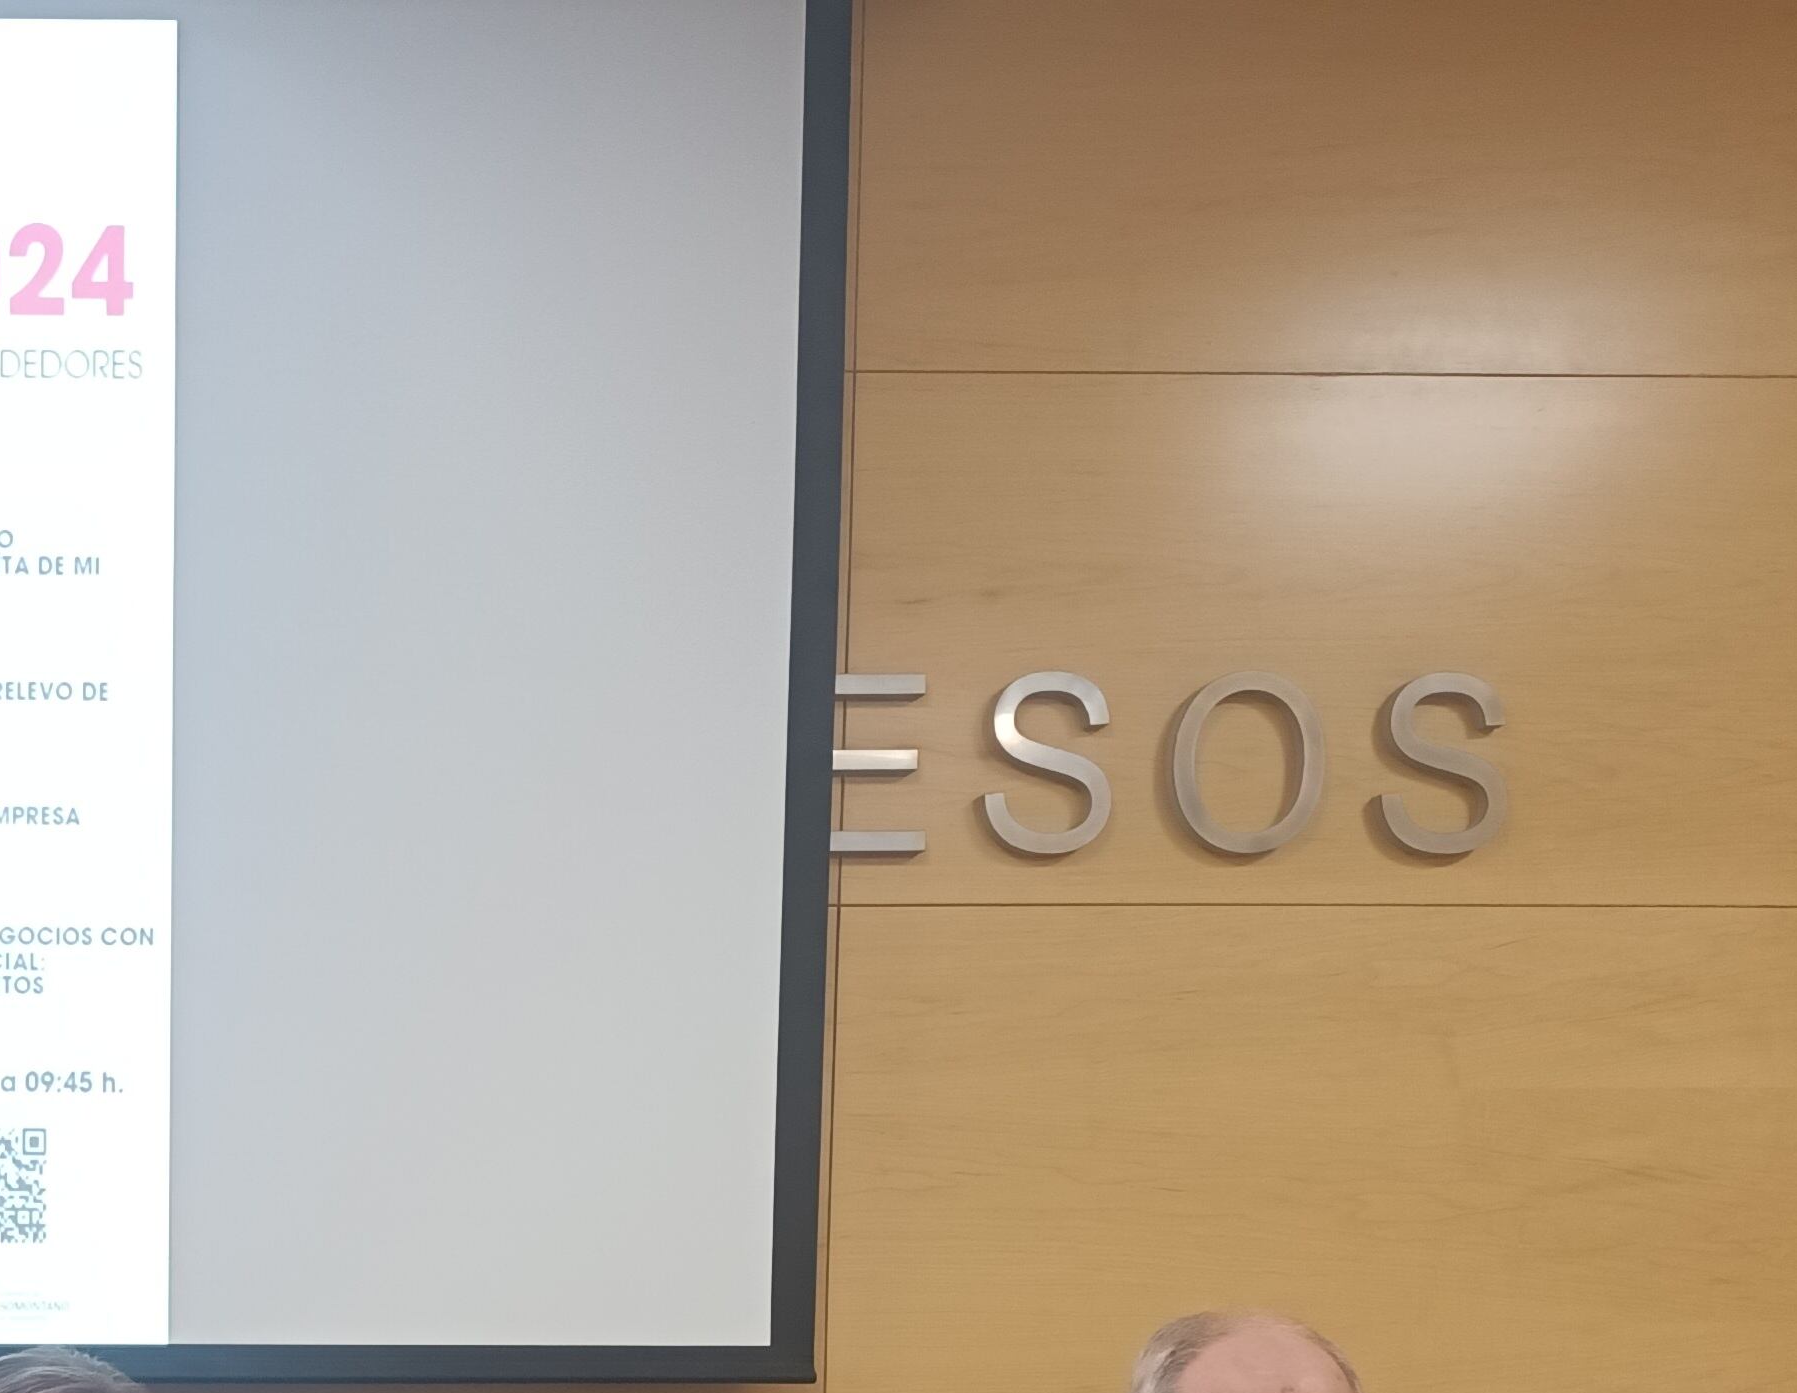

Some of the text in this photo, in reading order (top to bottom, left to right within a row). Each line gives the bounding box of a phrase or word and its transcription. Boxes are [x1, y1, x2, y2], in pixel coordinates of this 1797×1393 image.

[101, 927, 153, 946] CON
[1, 1076, 16, 1092] a
[25, 1071, 93, 1093] 09:45
[102, 1072, 123, 1093] h.
